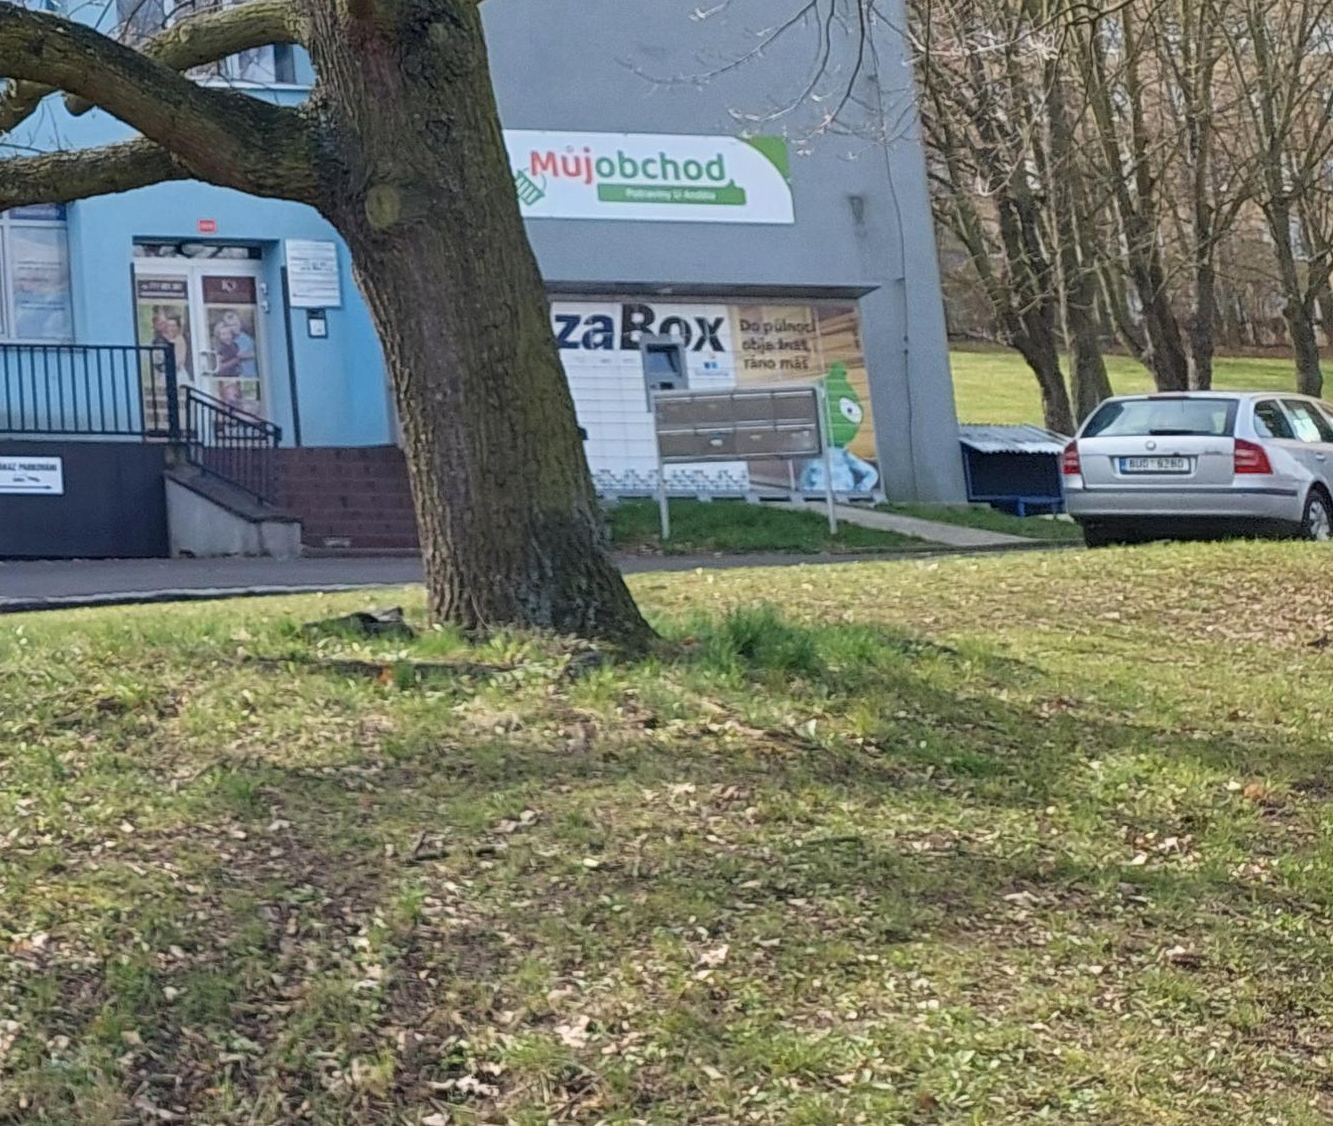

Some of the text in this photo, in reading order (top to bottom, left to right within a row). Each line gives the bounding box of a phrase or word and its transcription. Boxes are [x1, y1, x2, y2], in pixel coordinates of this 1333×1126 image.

[739, 318, 759, 333] Do
[744, 356, 777, 370] ráno
[780, 356, 809, 370] máš
